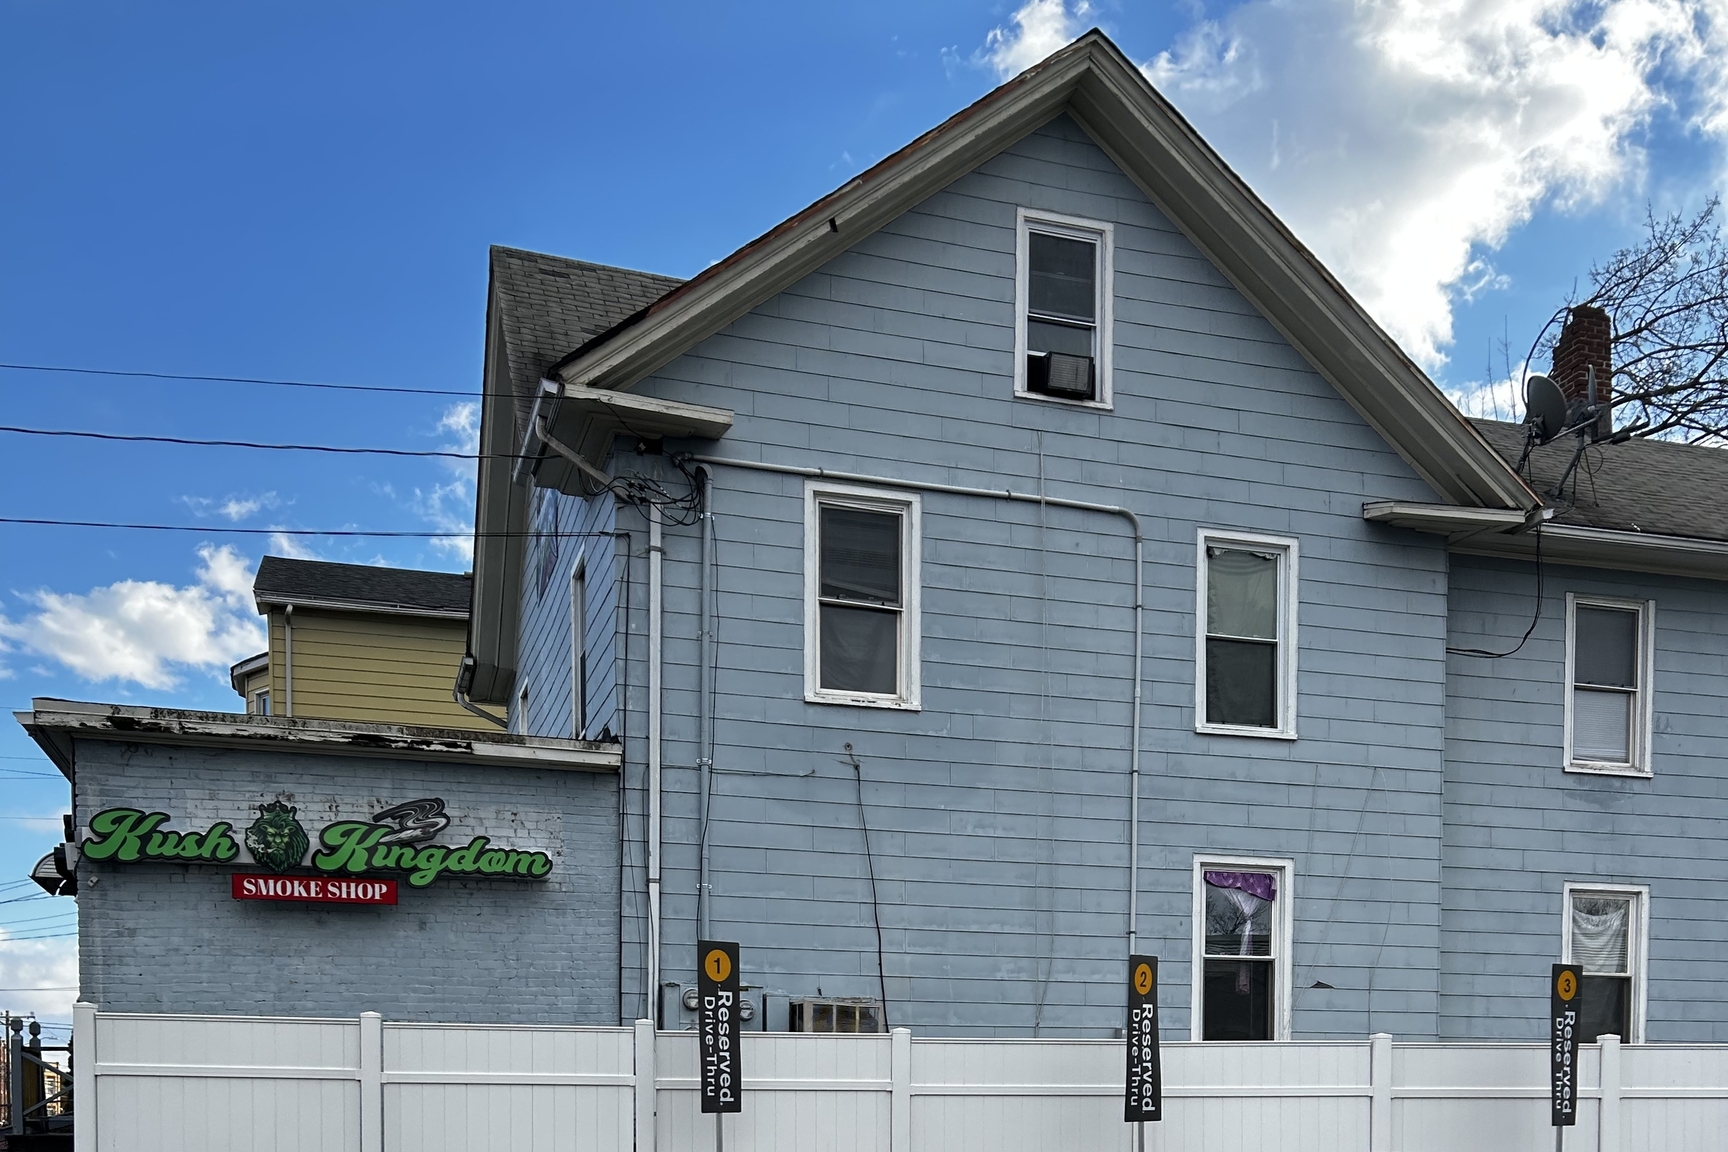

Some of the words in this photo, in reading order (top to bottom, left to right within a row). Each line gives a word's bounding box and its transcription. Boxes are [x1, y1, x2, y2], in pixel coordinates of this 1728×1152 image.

[82, 808, 238, 863] Kush
[314, 821, 551, 887] Kingdom
[242, 877, 322, 898] SMOKE
[326, 880, 388, 900] SHOP
[713, 957, 720, 974] 1
[1139, 971, 1147, 988] 2
[1563, 978, 1571, 993] 3
[704, 996, 718, 1096] Drive-Thru
[717, 991, 734, 1102] Reserved
[1130, 1009, 1142, 1106] Drive-Thru
[1141, 1003, 1156, 1112] Reserved
[1562, 1011, 1576, 1113] Reserved
